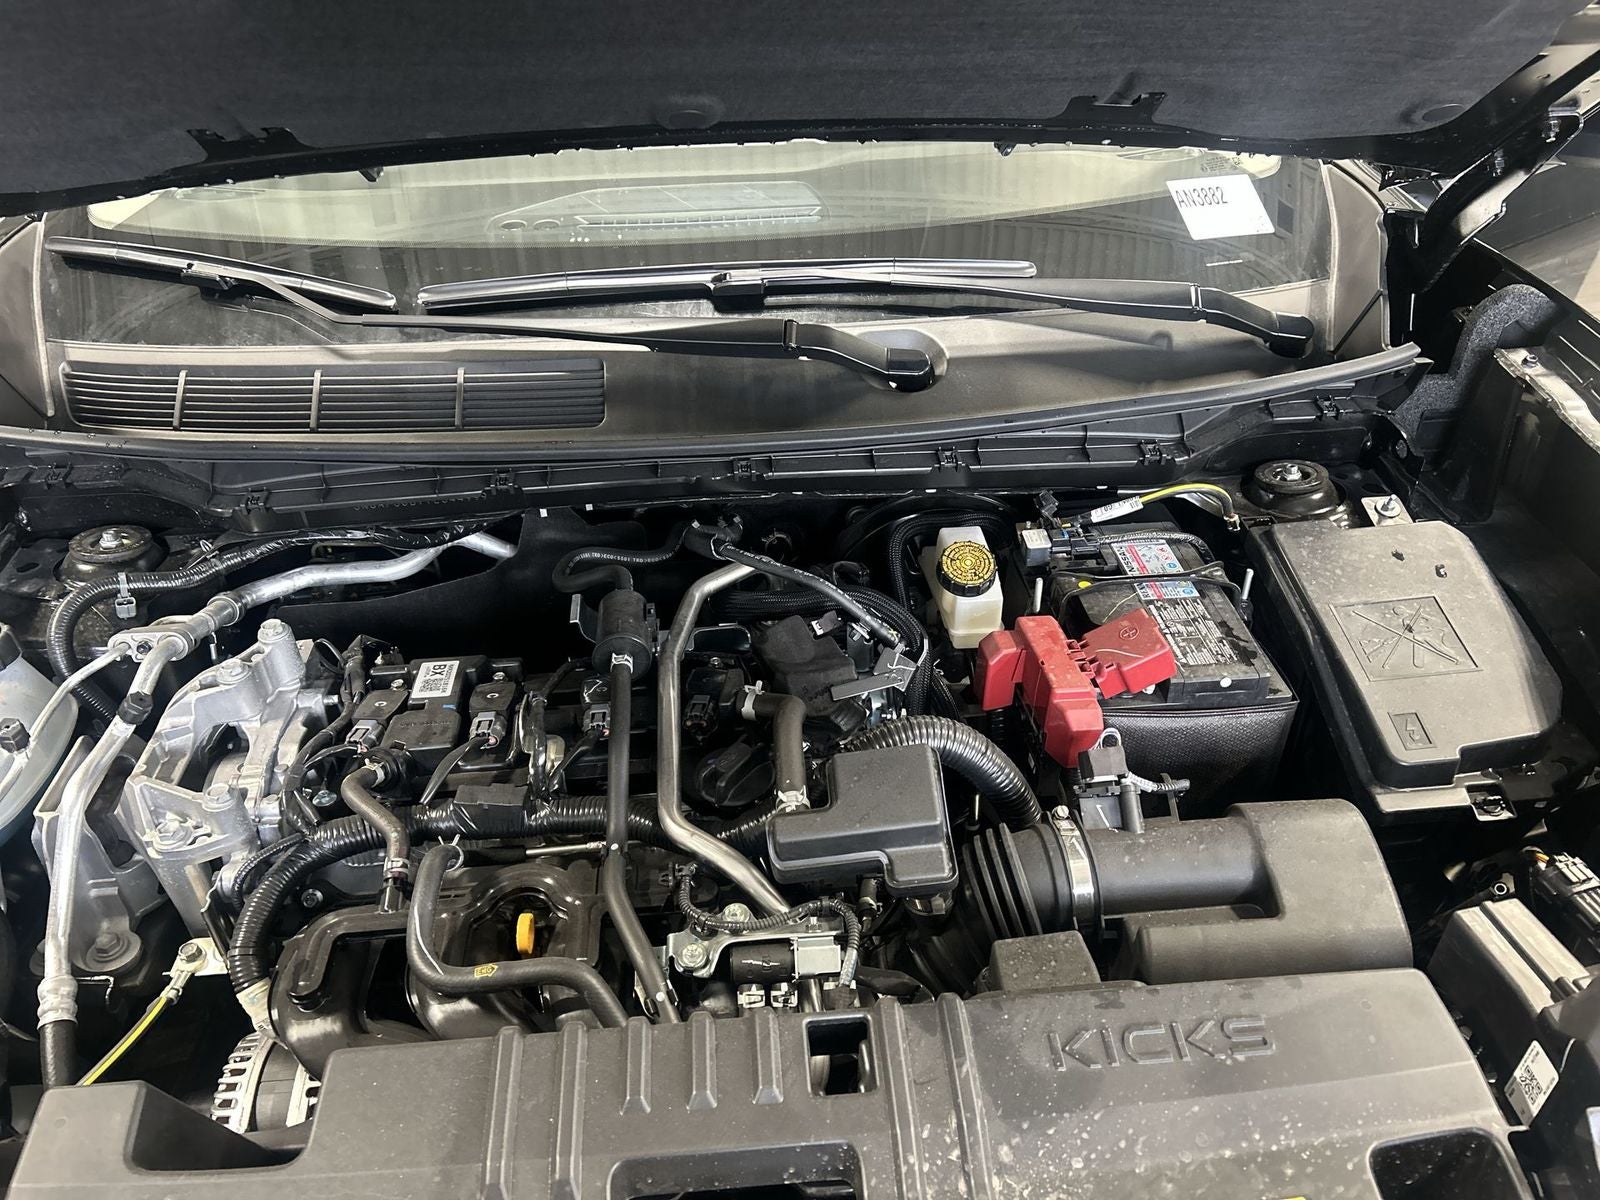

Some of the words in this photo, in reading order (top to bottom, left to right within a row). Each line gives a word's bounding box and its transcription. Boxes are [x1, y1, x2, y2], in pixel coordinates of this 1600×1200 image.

[1175, 186, 1229, 208] AN3882
[430, 664, 447, 677] BX
[1047, 1015, 1276, 1072] KICKS
